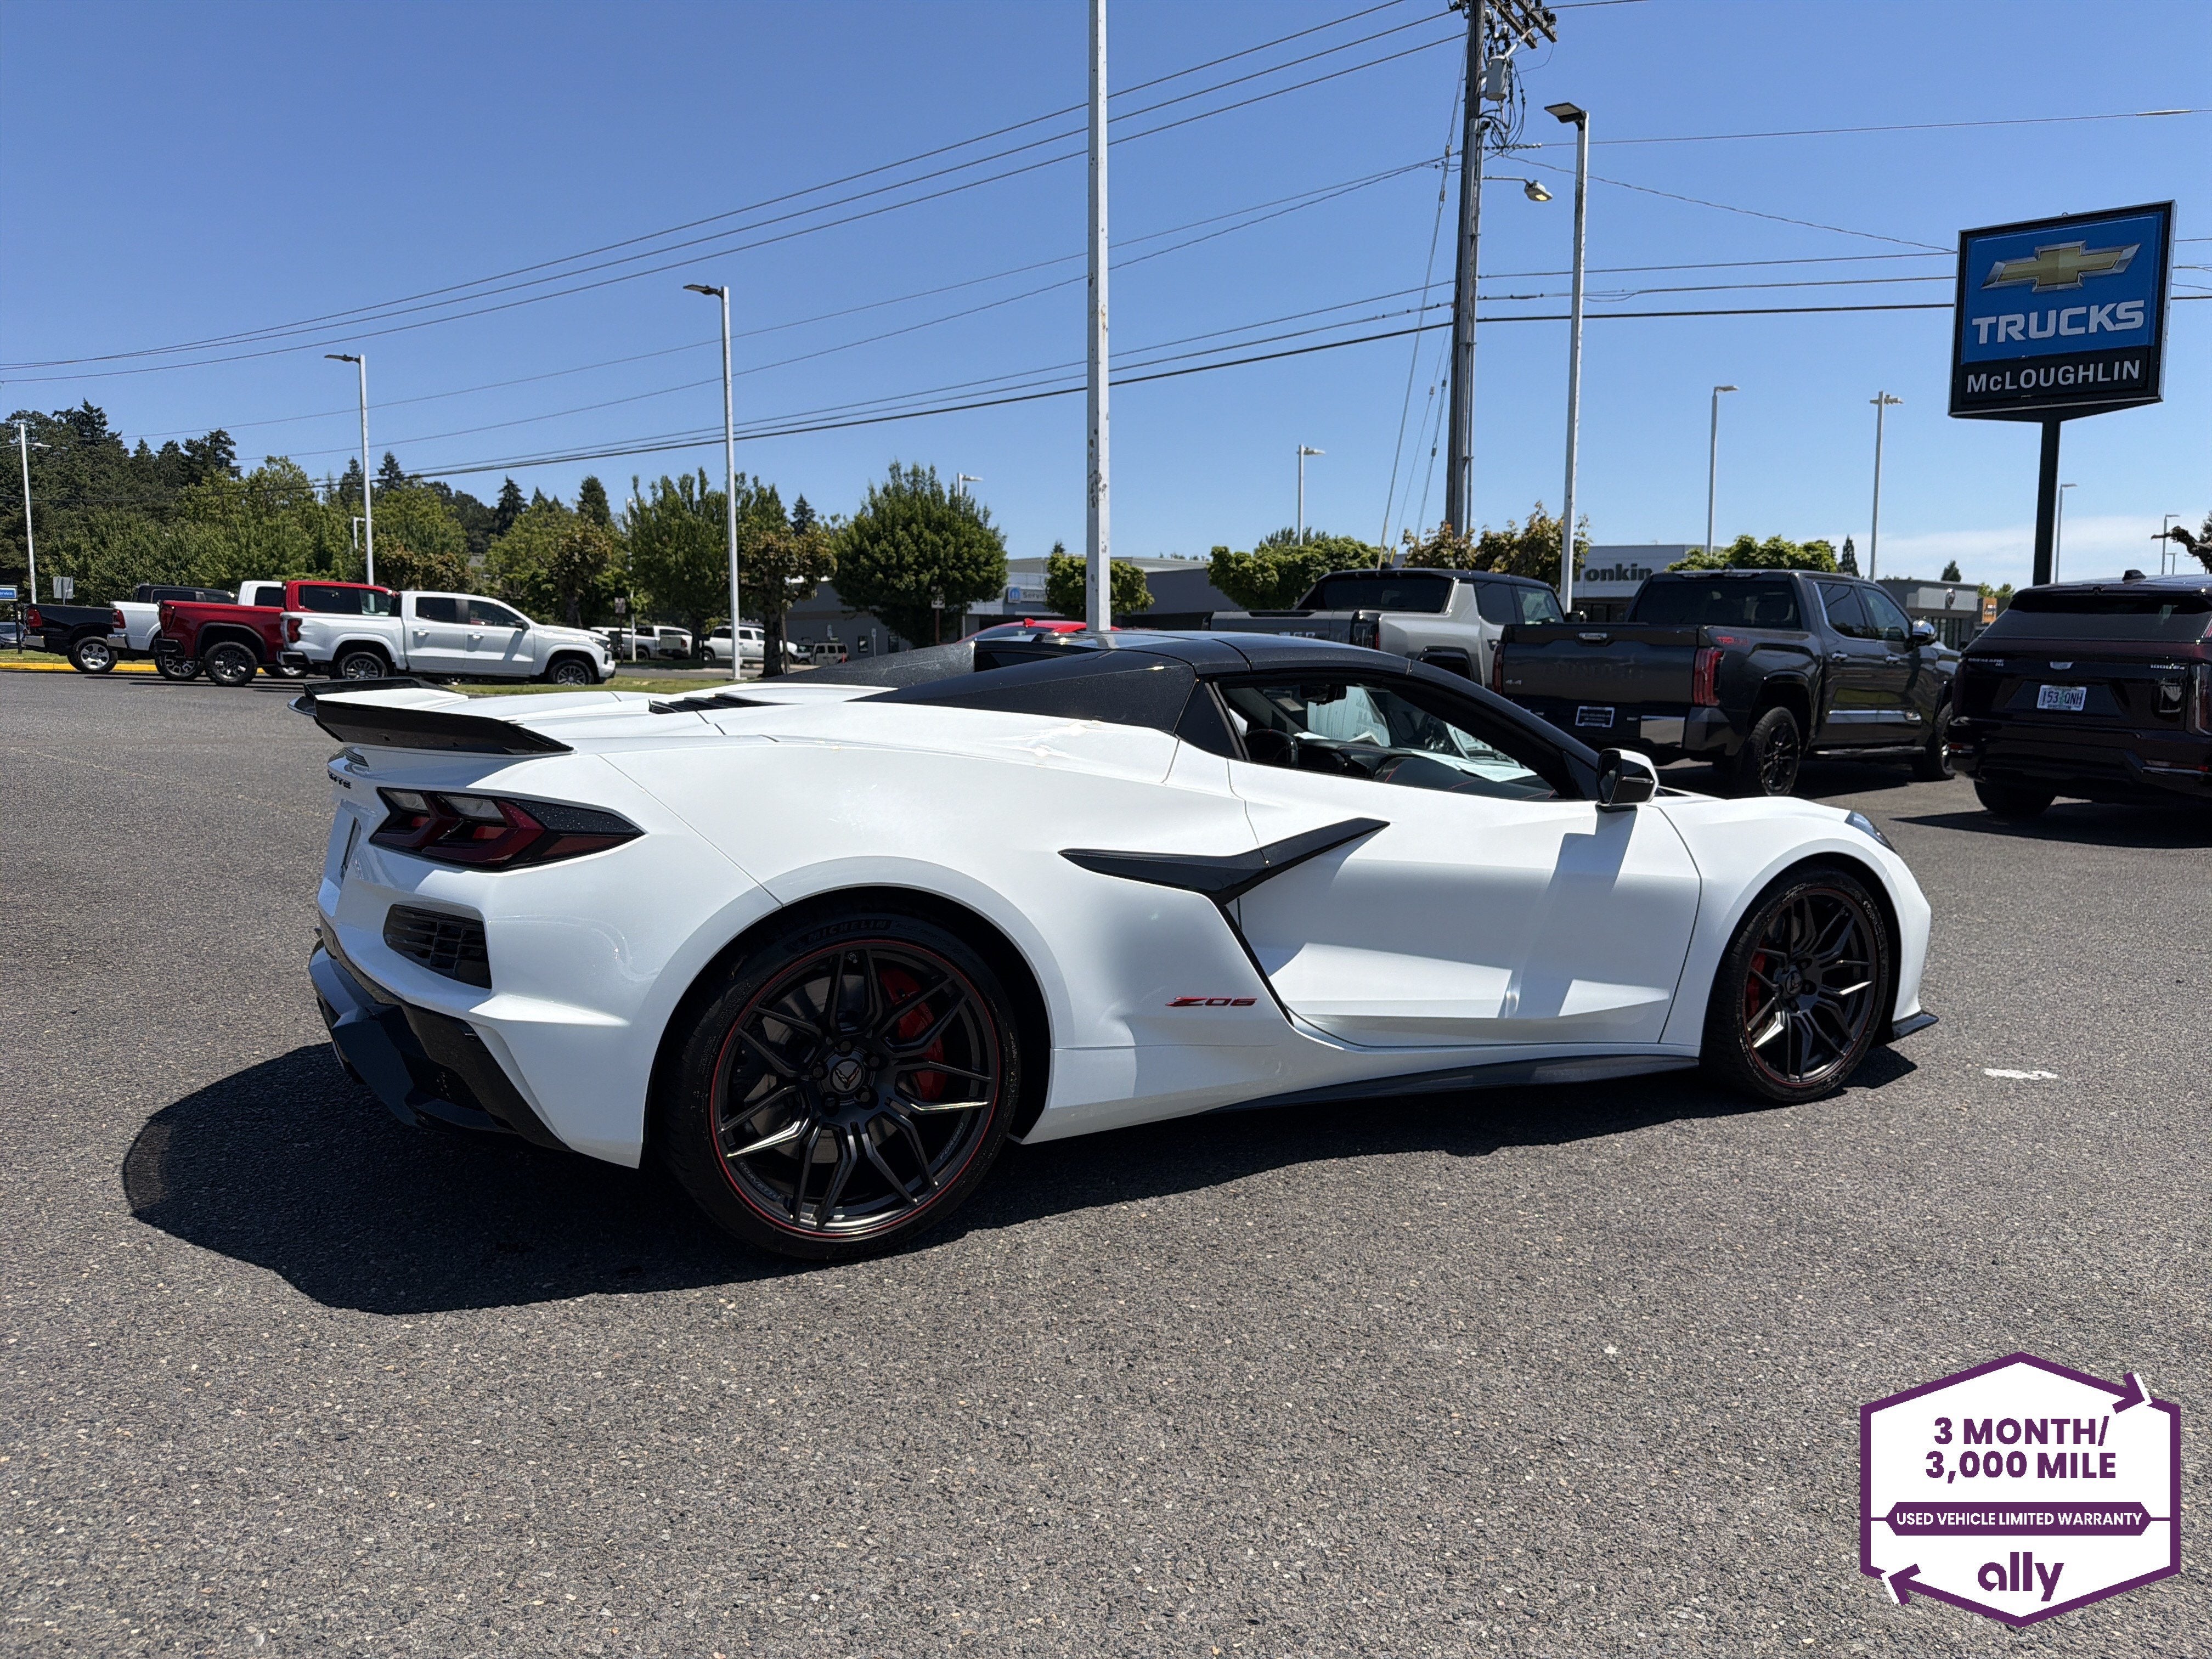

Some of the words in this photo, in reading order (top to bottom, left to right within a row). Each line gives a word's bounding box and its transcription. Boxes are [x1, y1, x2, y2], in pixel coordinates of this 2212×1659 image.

[1972, 300, 2144, 345] TRUCKS
[1967, 360, 2140, 393] McLOUGHLIN
[2041, 691, 2059, 705] 153
[808, 919, 889, 944] MICHELIN
[1165, 996, 1257, 1007] Z06
